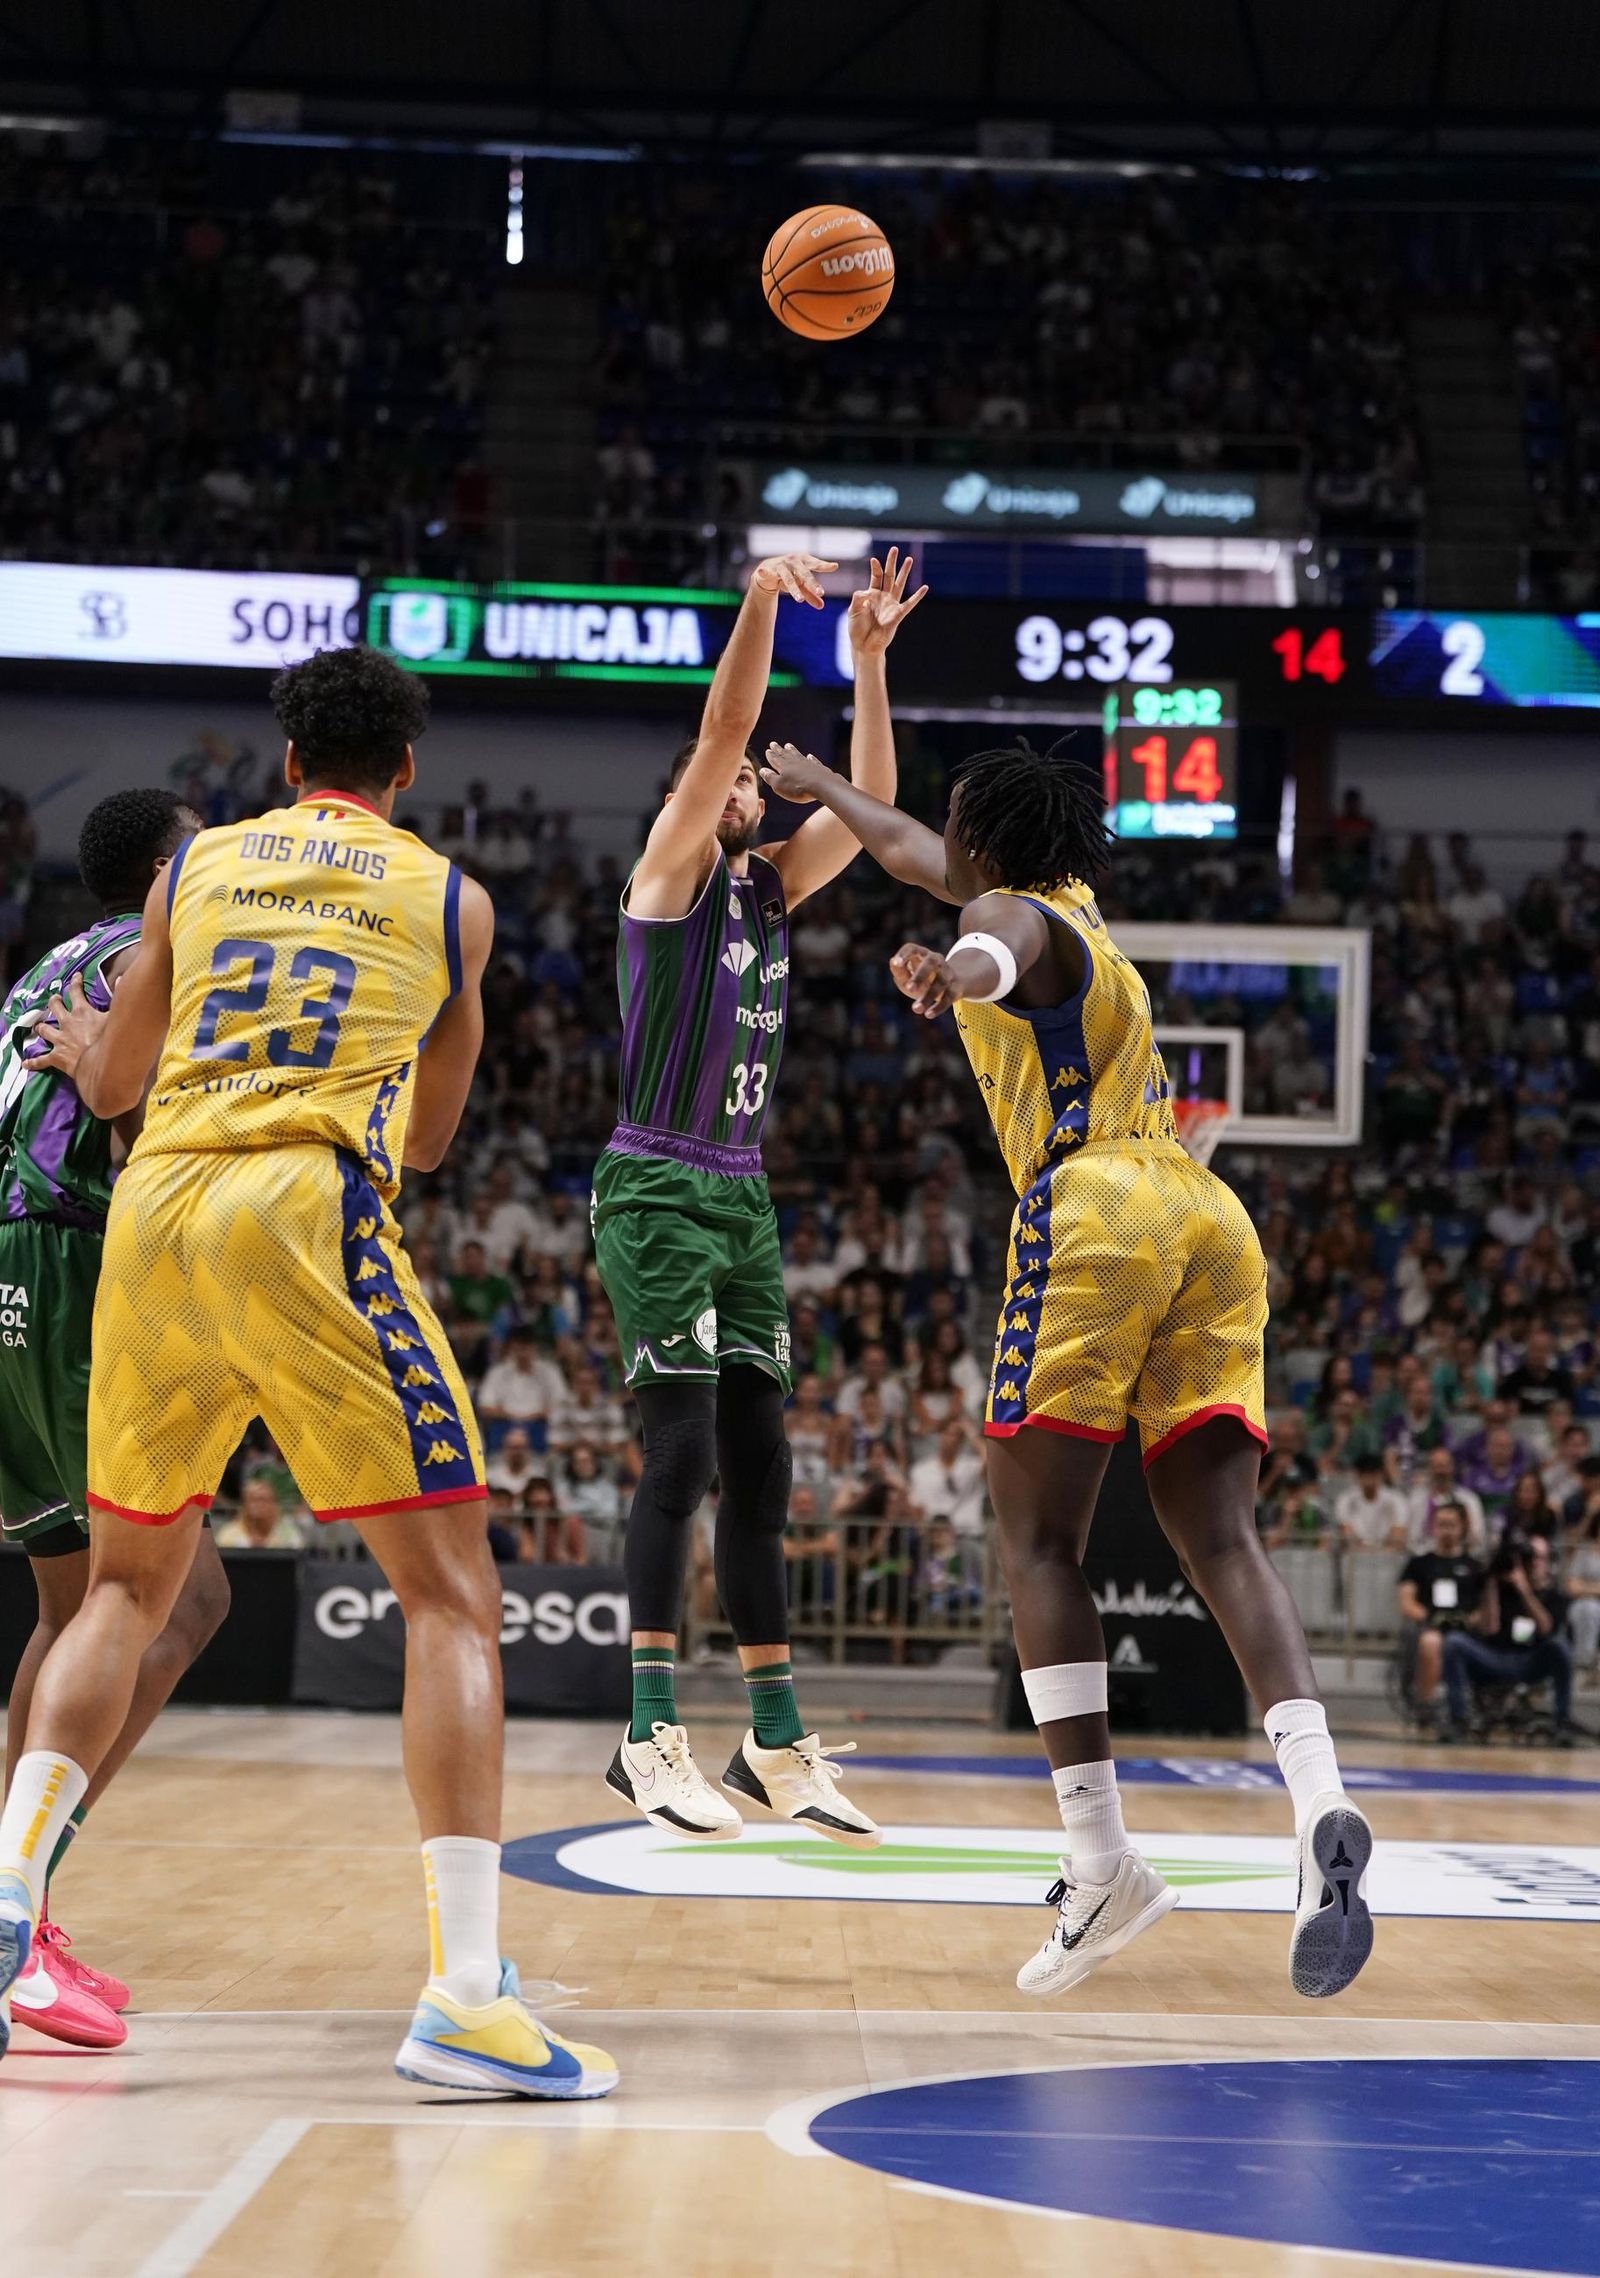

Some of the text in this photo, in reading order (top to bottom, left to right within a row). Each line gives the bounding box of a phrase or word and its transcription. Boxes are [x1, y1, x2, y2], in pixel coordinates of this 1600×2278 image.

[821, 246, 892, 276] Wilson
[484, 600, 704, 664] UNICAJA
[1016, 615, 1174, 683] 9:32
[1273, 627, 1346, 684] 14
[1441, 620, 1485, 695] 2
[1132, 687, 1223, 726] 9:32
[1131, 735, 1224, 803] 14
[240, 832, 387, 880] DOS ANJOS
[231, 886, 394, 937] MORABANC
[188, 938, 357, 1069] 23
[725, 1062, 768, 1116] 33
[0, 1283, 29, 1307] TA
[0, 1309, 27, 1328] OL
[2, 1330, 27, 1348] GA
[314, 1585, 631, 1646] enesa
